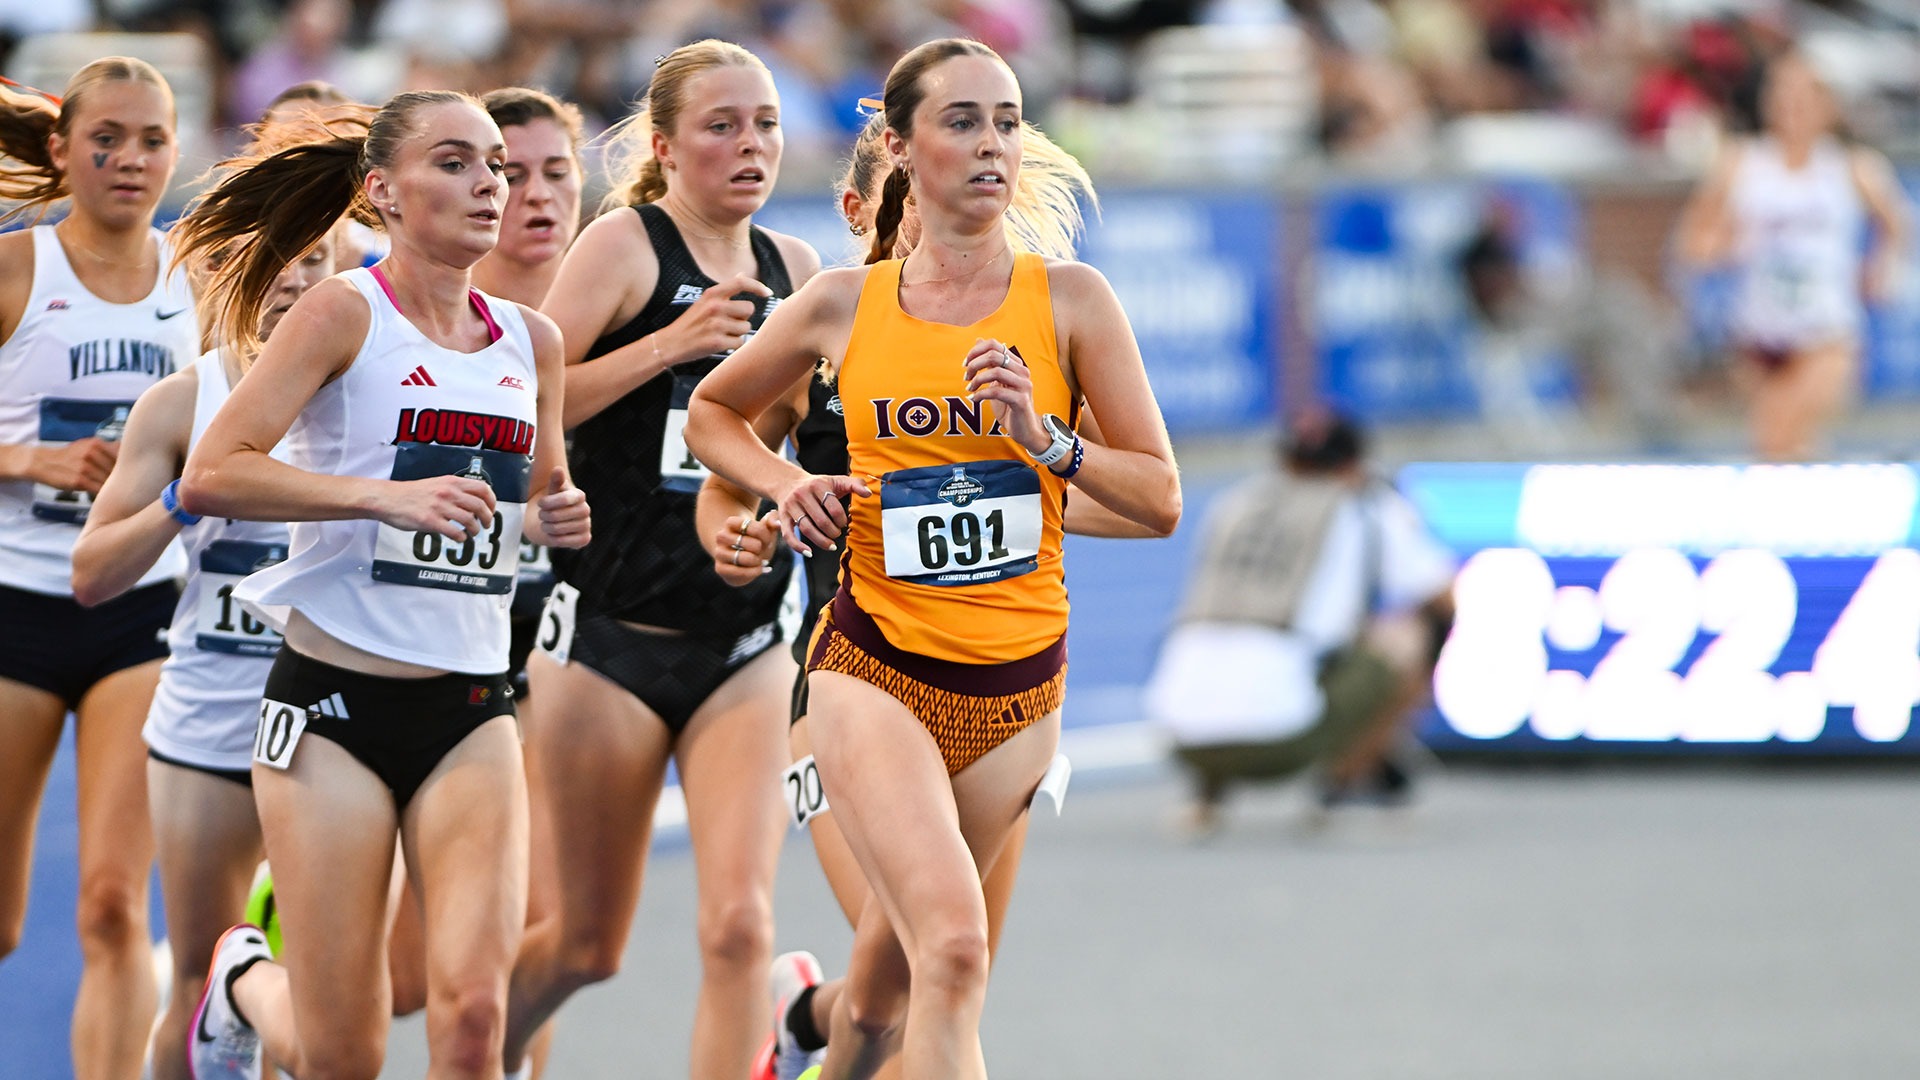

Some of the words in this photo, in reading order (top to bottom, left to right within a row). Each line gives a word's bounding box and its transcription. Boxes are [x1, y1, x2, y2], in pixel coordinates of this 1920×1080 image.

[678, 284, 703, 294] BIG
[674, 292, 701, 300] EAS
[499, 376, 523, 388] ACC
[392, 408, 535, 455] LOUISVILLE
[940, 486, 983, 496] CHAMPIONSHIPS
[917, 509, 1009, 570] 691
[418, 570, 459, 584] LEXINGTON,
[938, 573, 971, 582] LEXINGTON,
[972, 569, 1001, 581] KENTUCKY
[256, 702, 294, 762] 10
[788, 761, 823, 823] 20
